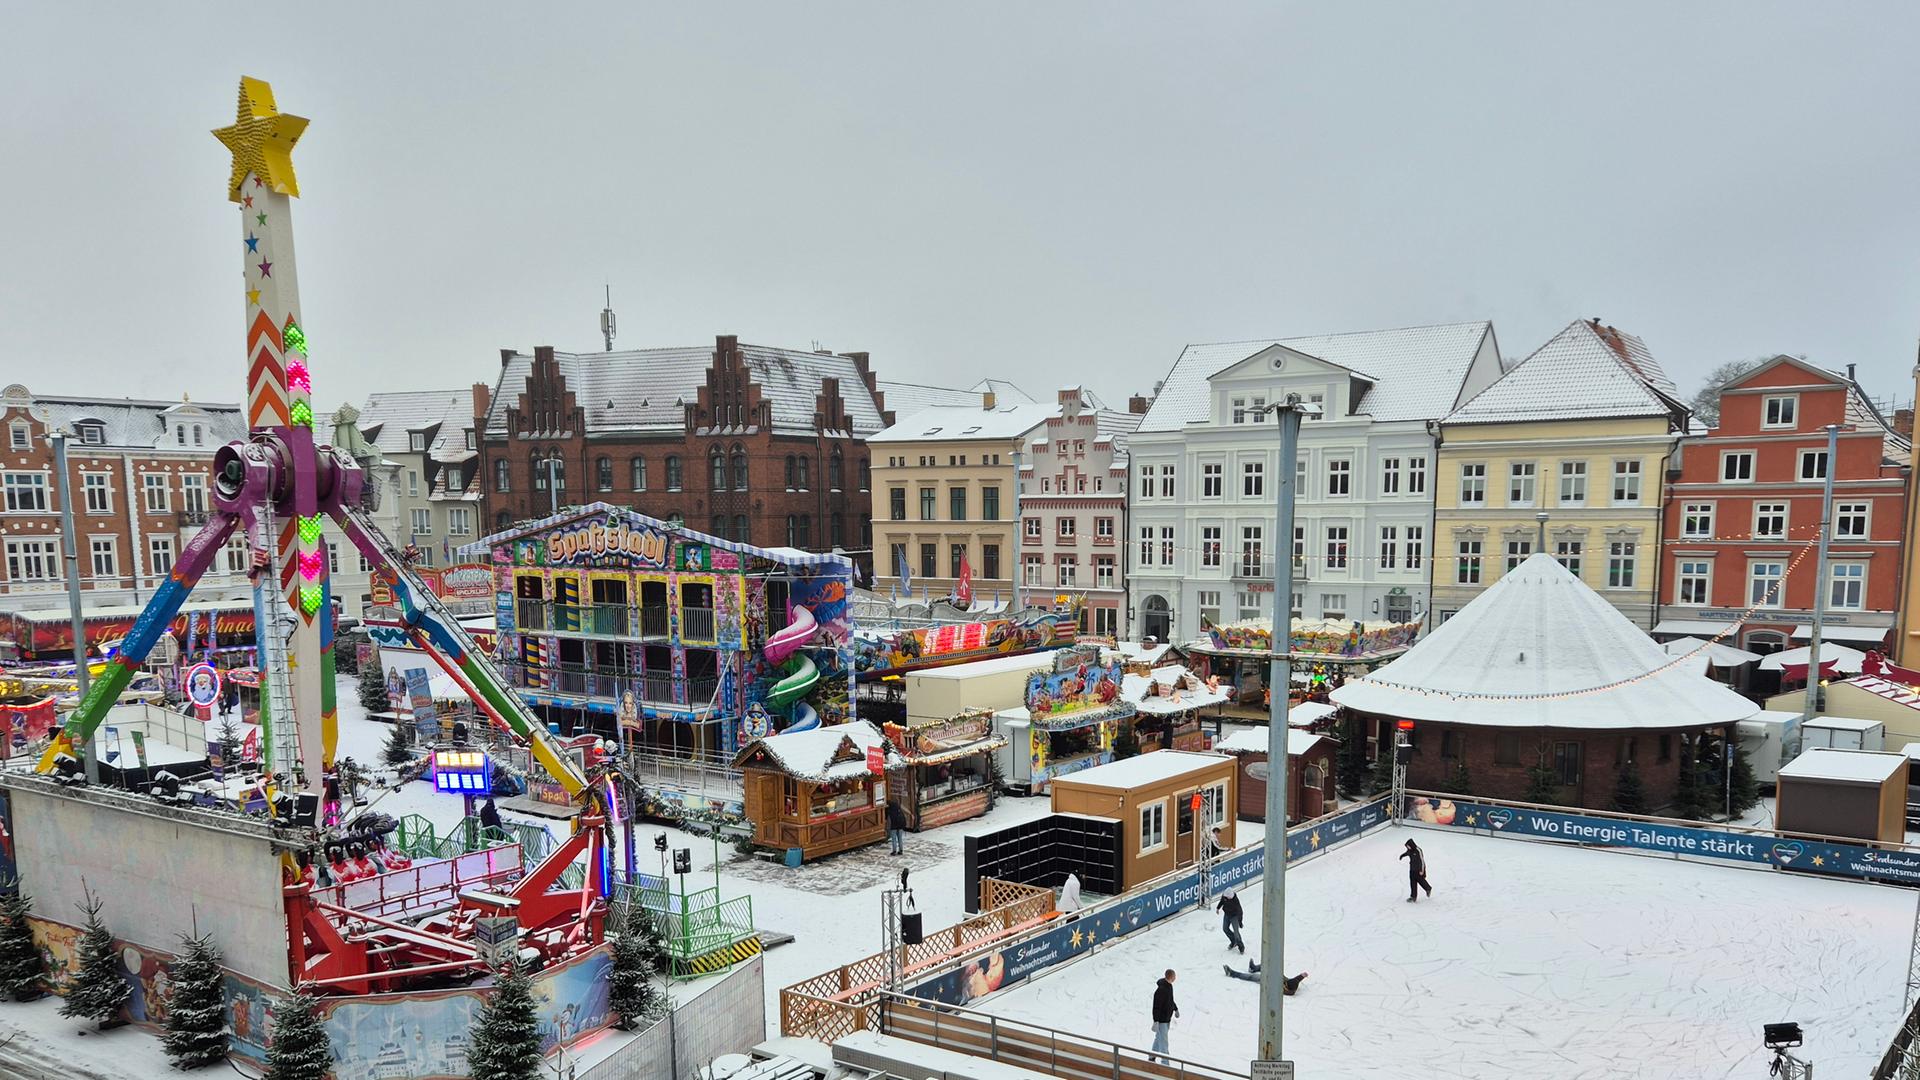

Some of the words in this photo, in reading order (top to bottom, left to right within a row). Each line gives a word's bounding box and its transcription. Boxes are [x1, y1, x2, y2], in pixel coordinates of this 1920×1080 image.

[1530, 816, 1559, 833] Wo
[1563, 821, 1627, 842] Energie
[1631, 828, 1697, 850] Talente
[1701, 837, 1754, 857] stärkt
[1155, 896, 1172, 912] Wo
[1173, 883, 1205, 905] Energ
[1210, 866, 1241, 889] Talente
[1242, 854, 1265, 876] stärkt
[1850, 862, 1920, 878] Weihnachtsmar
